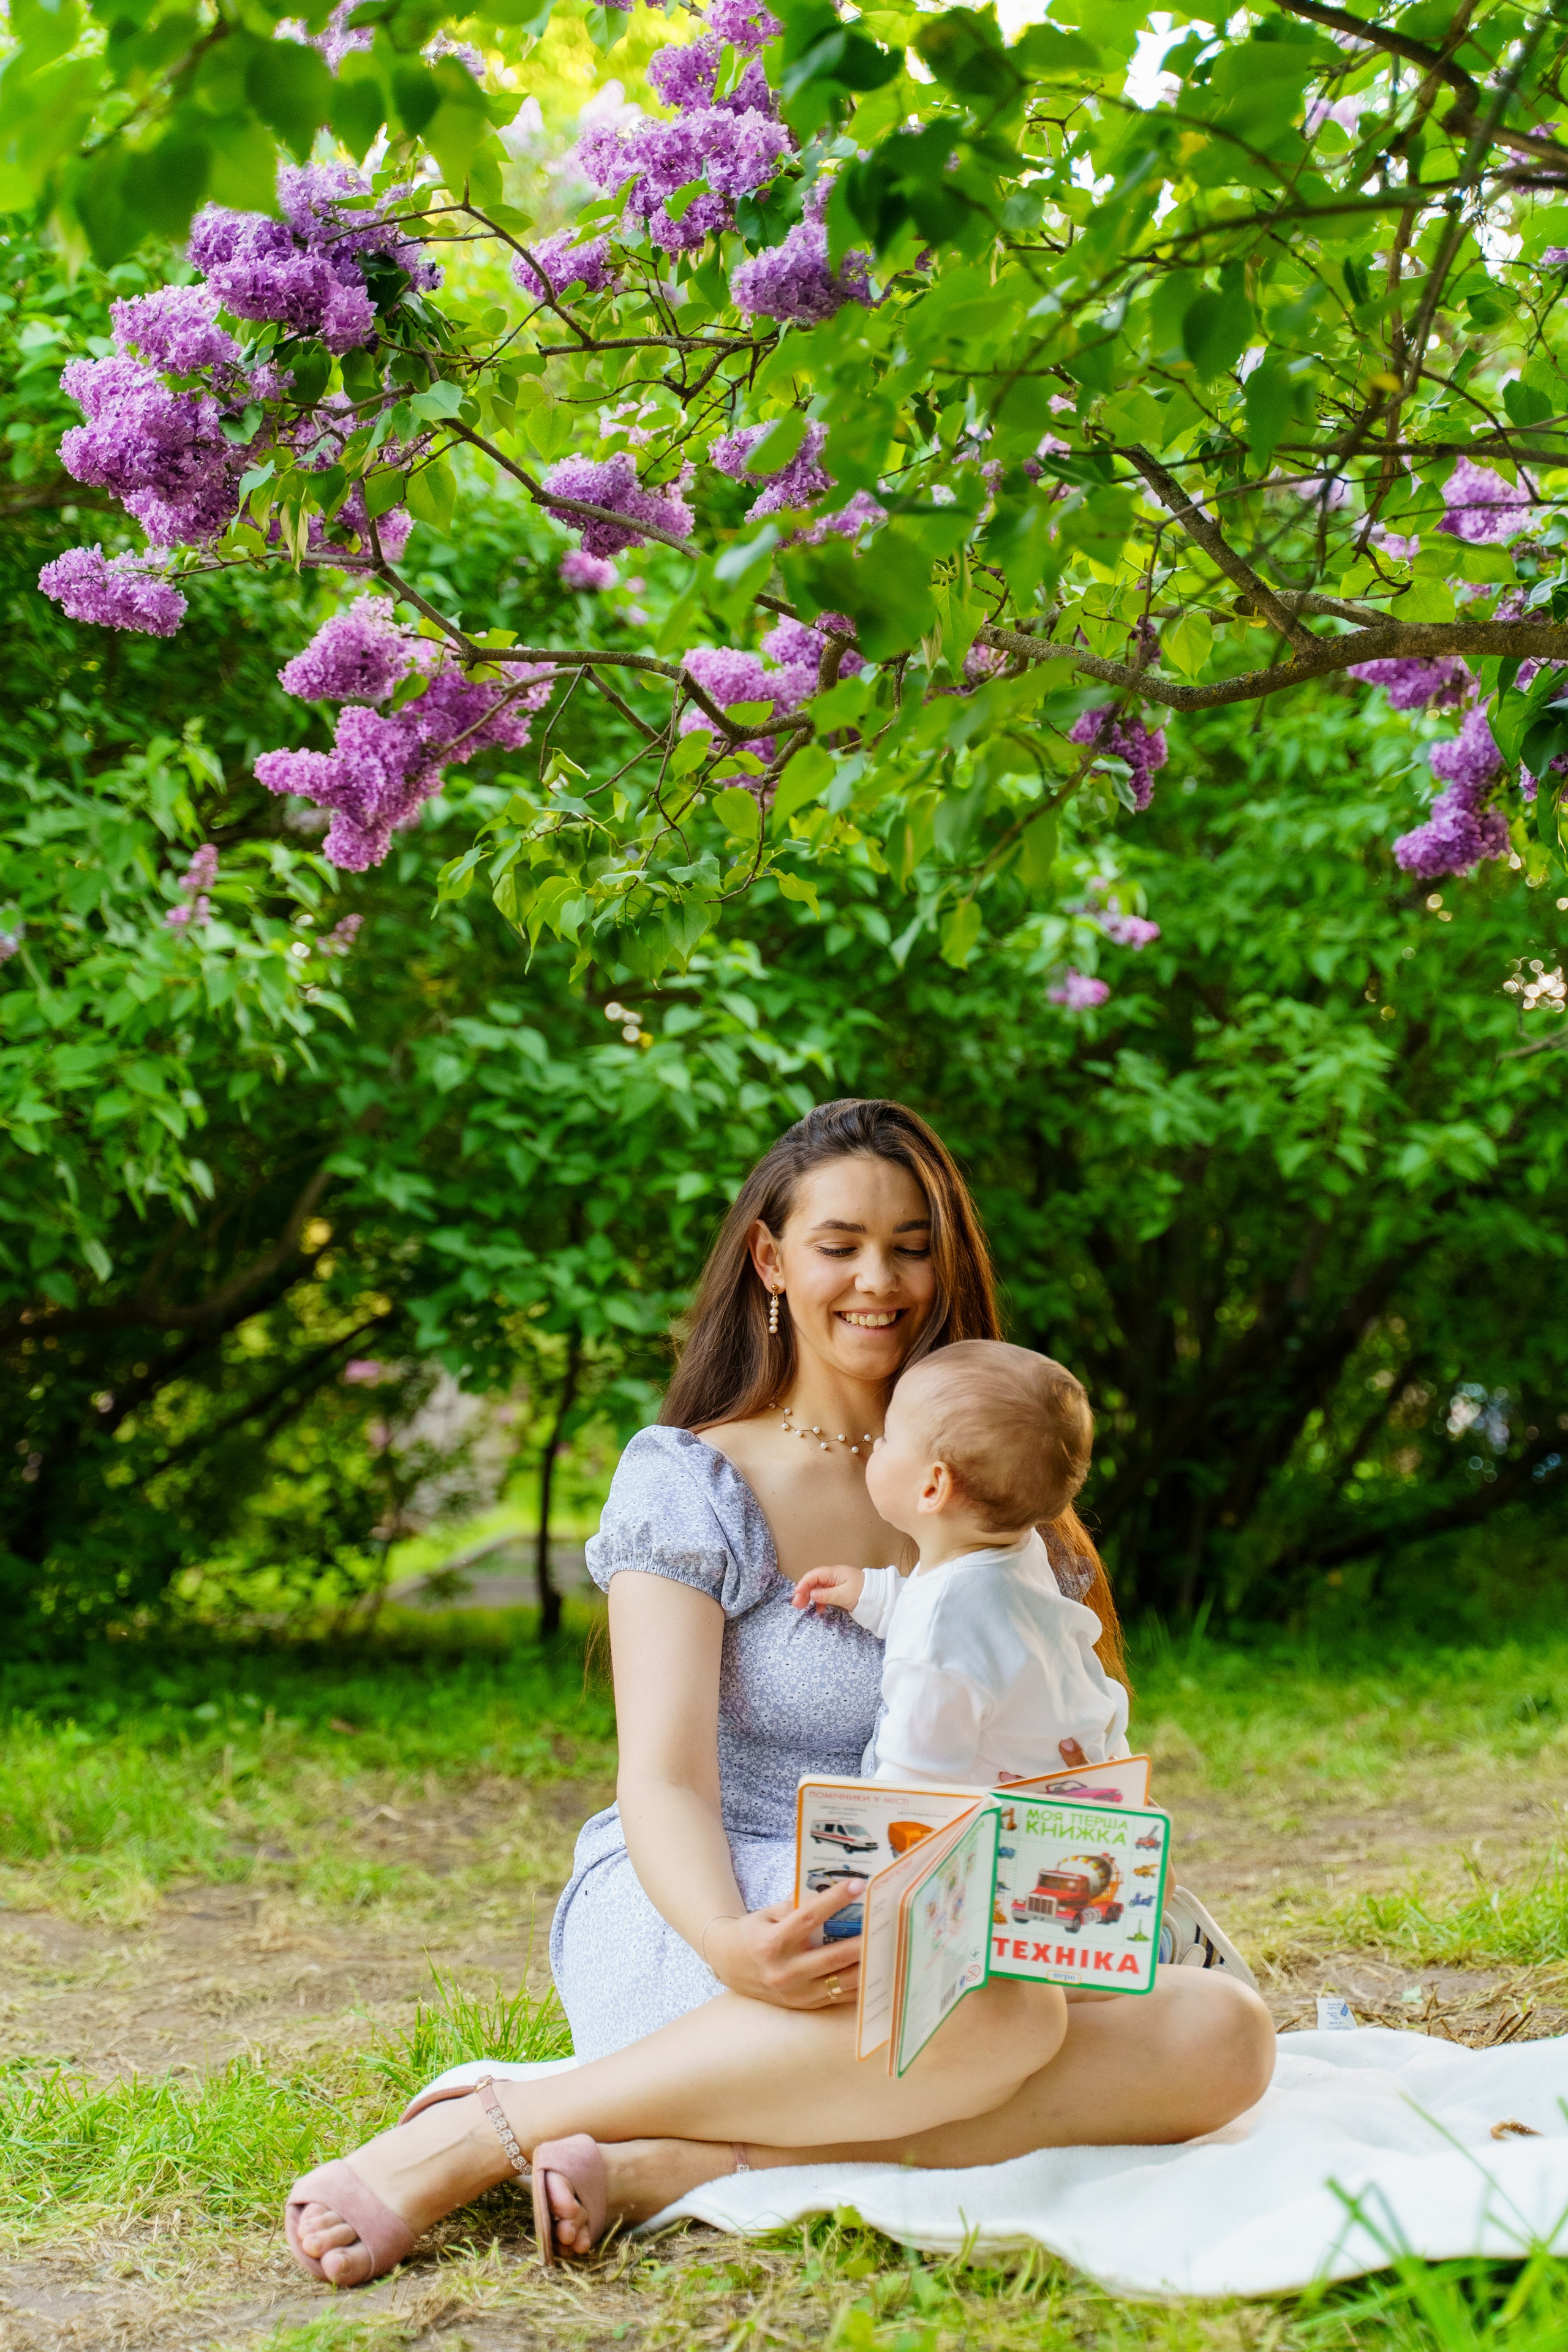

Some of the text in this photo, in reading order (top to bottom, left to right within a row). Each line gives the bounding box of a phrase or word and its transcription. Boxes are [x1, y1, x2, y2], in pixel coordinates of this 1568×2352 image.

[809, 1792, 870, 1801] ПОМІЧНИКИ
[1027, 1808, 1128, 1830] МОЯ ПЕРША
[1026, 1819, 1126, 1846] КНИЖКА
[992, 1937, 1140, 1975] ТЕХНІКА
